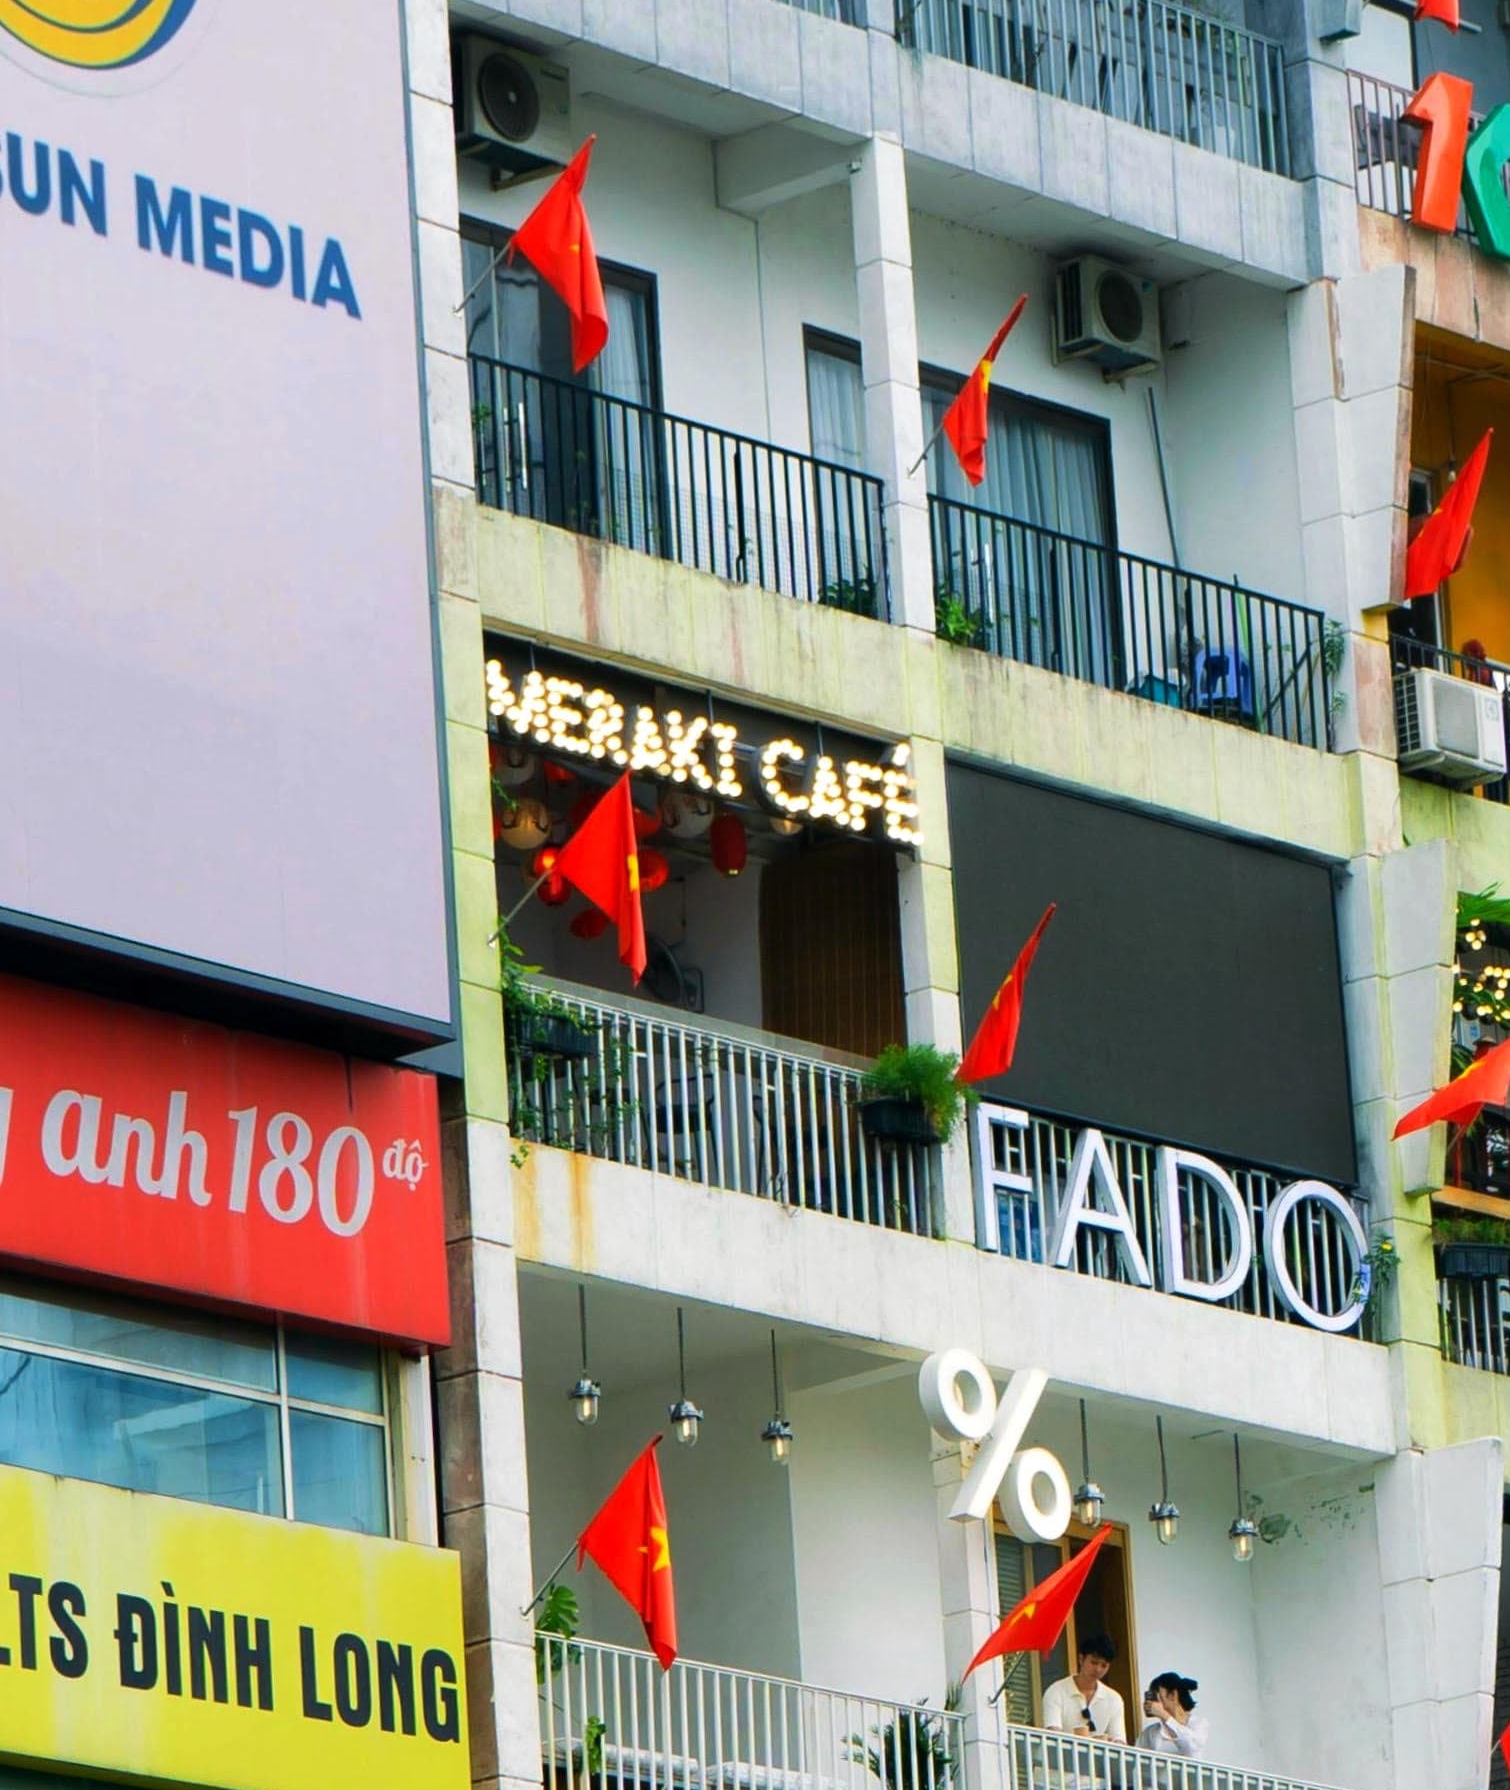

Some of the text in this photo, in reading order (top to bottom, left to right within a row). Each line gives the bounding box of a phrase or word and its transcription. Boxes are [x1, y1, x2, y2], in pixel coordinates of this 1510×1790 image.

[0, 129, 363, 322] UN MEDIA
[487, 660, 743, 799] MERAKI
[40, 1088, 213, 1207] anh
[227, 1104, 376, 1237] 180
[382, 1137, 431, 1192] độ
[971, 1101, 1372, 1334] FADO
[0, 1572, 461, 1744] TS ĐÌNH LONG
